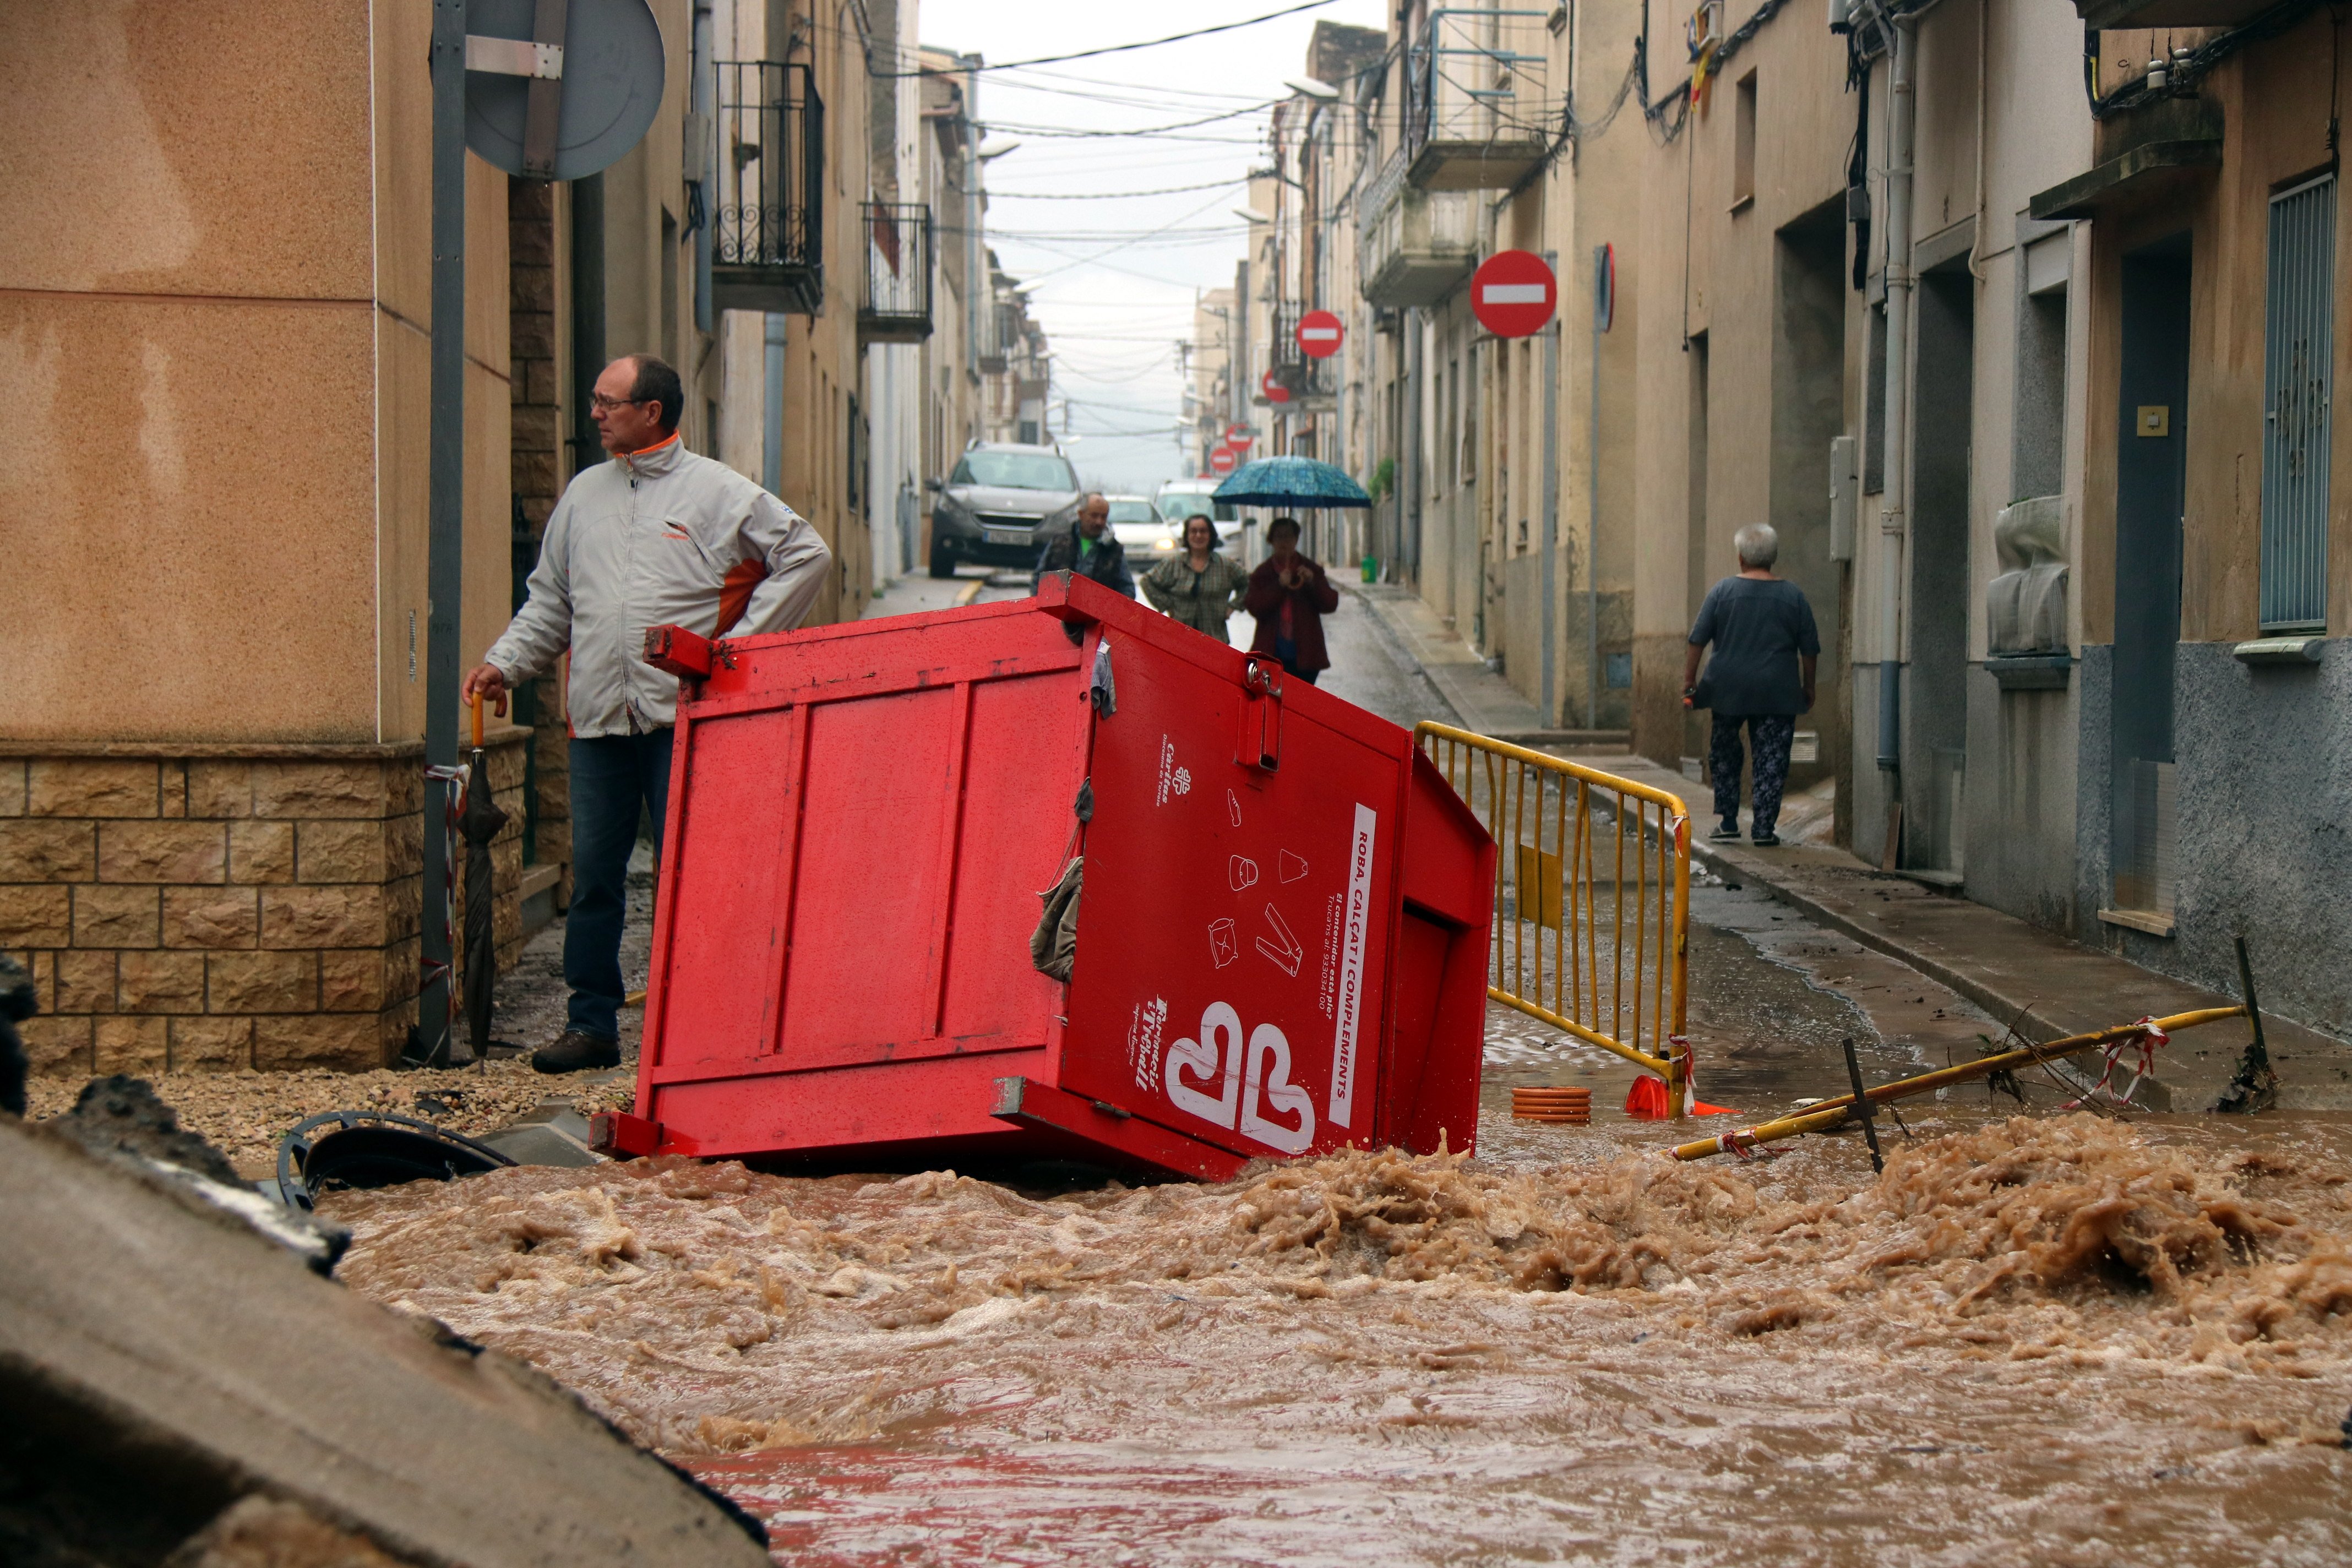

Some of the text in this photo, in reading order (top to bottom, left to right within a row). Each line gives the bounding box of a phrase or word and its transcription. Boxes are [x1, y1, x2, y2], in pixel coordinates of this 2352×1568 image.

[1159, 770, 1163, 778] de
[1162, 743, 1174, 803] Càritas
[1355, 831, 1368, 882] ROBA,
[1325, 895, 1335, 937] Truca'ns
[1336, 892, 1342, 903] El
[1349, 889, 1363, 955] CALÇAT
[1330, 905, 1341, 967] contenidor
[1319, 954, 1329, 1010] 933034100
[1136, 1010, 1156, 1091] Treball
[1150, 994, 1167, 1093] Formació
[1337, 969, 1355, 1099] COMPLEMENTS
